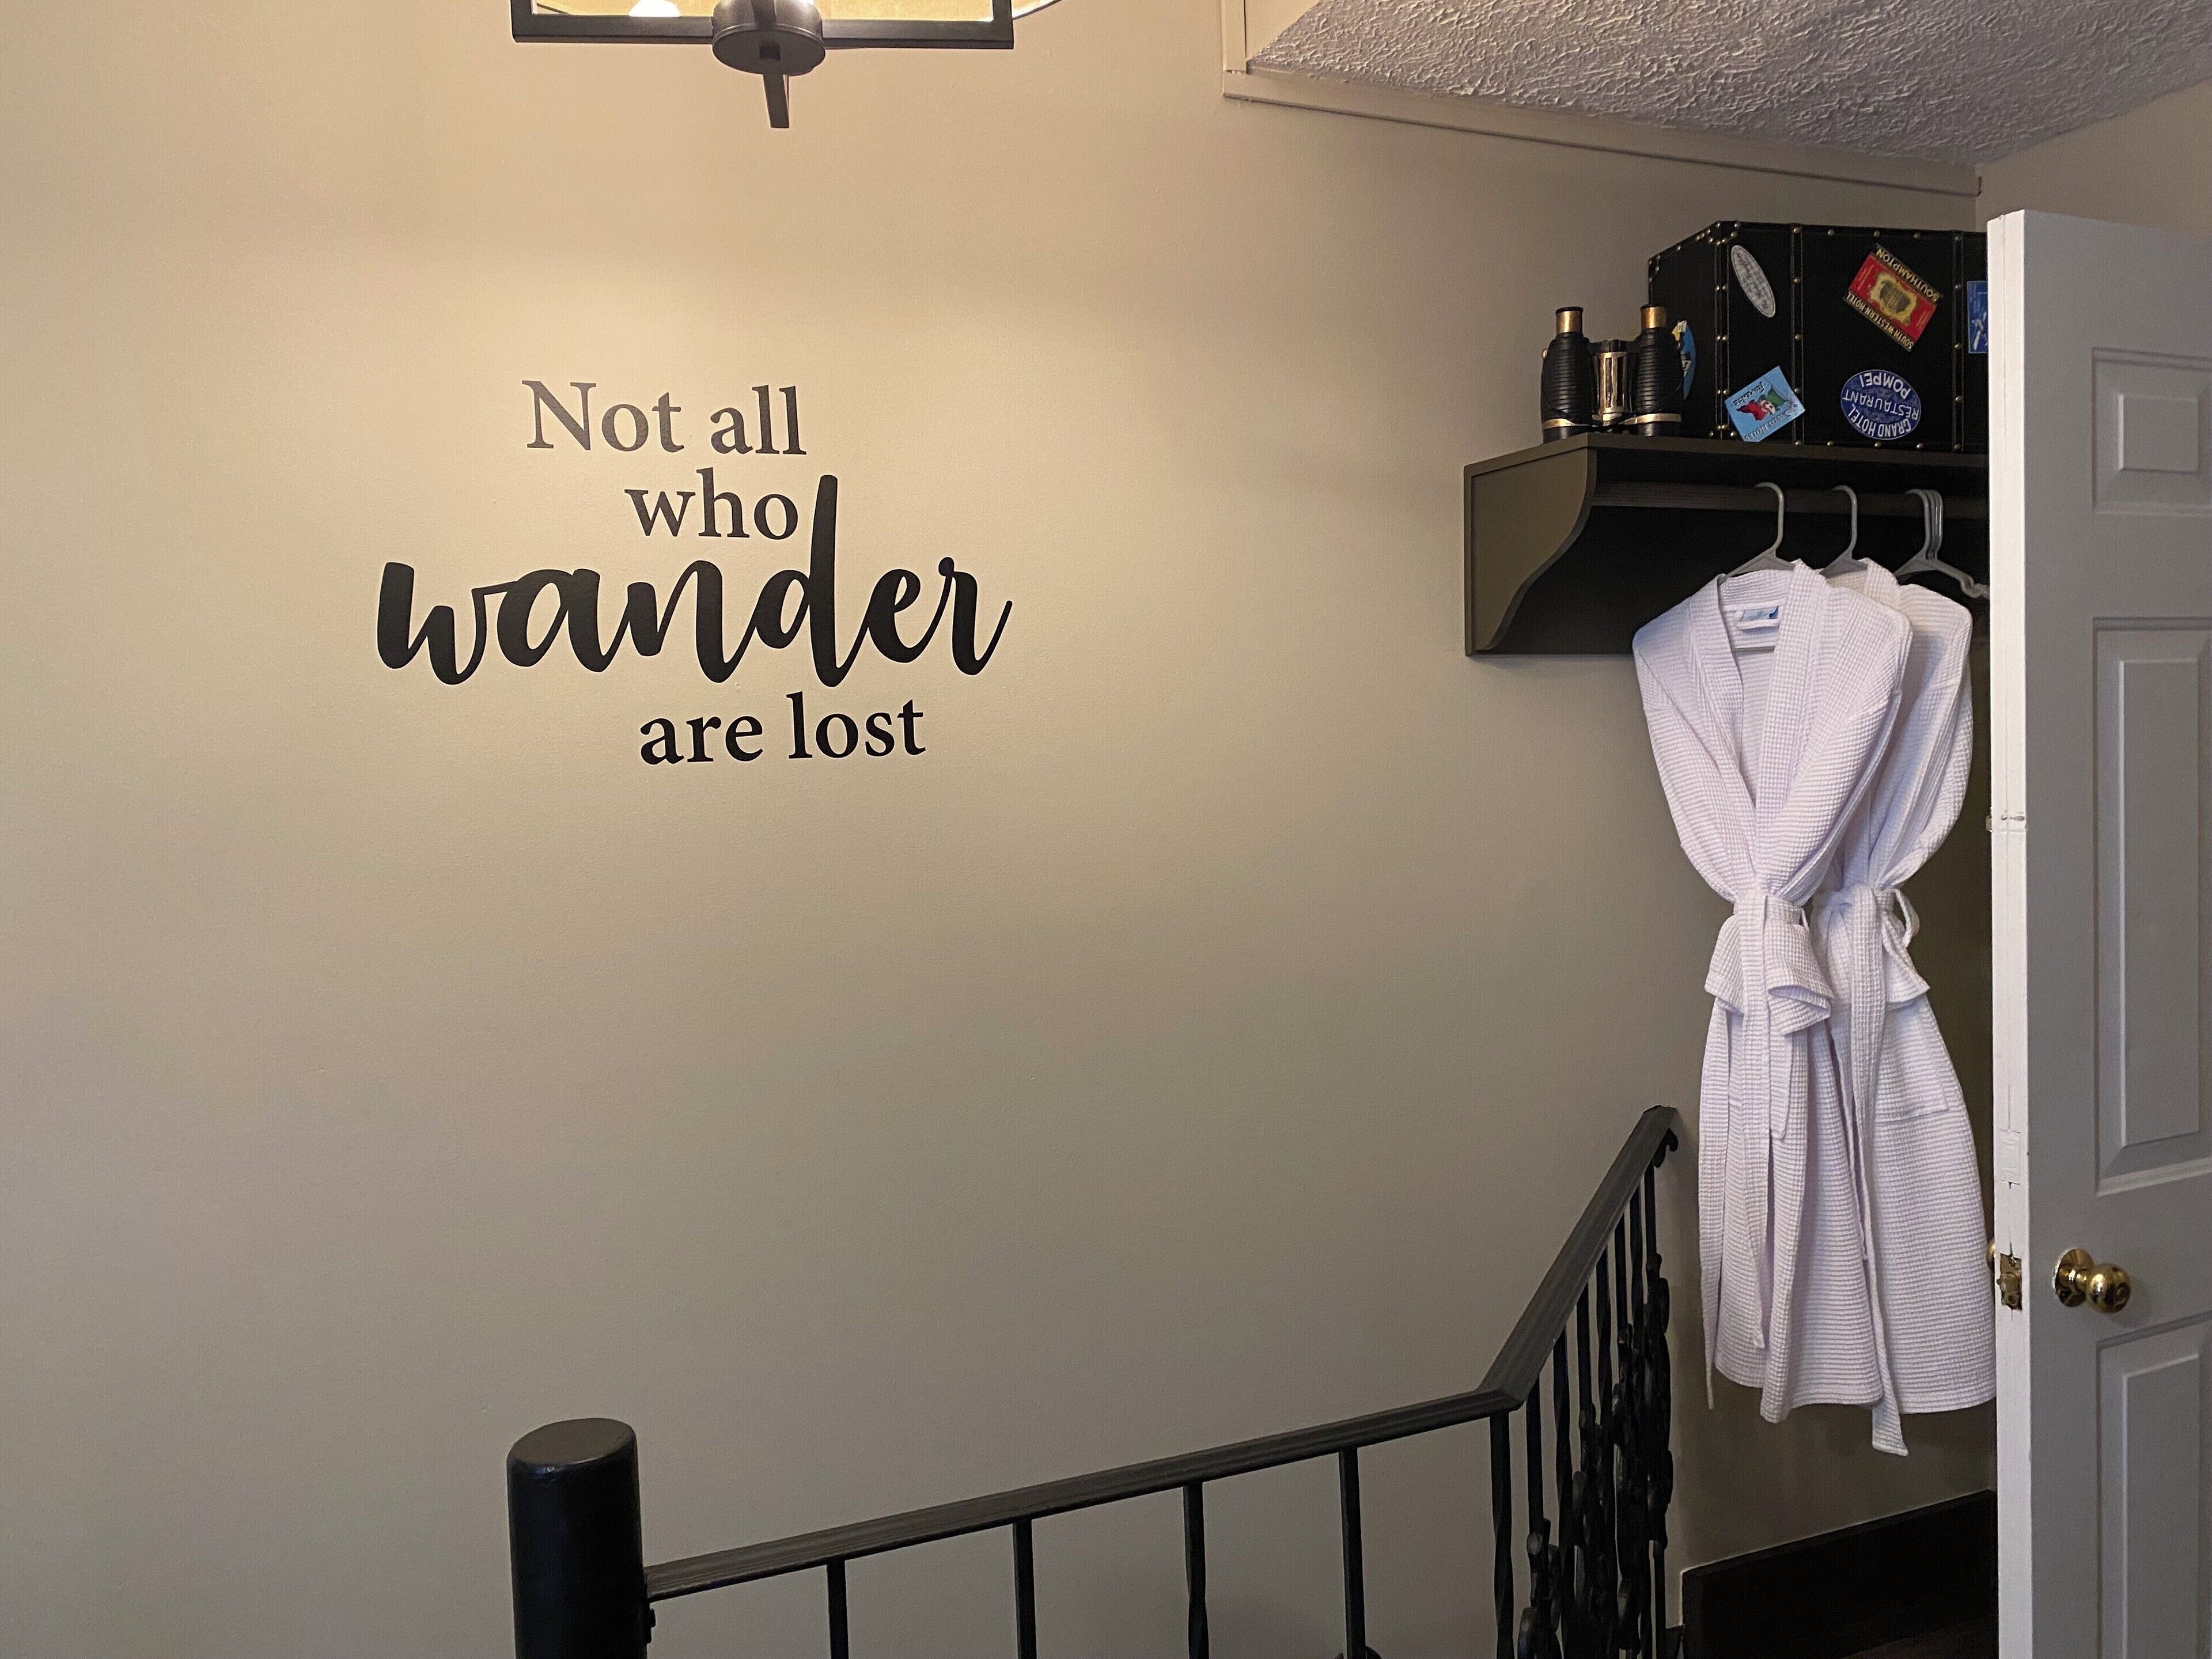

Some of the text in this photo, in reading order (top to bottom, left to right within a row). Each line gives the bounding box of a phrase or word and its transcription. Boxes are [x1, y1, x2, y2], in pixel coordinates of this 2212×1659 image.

[1876, 248, 1940, 302] SOUTHAMPTON
[1846, 291, 1866, 312] HOTEL
[1842, 389, 1919, 421] RESTAURANT
[1859, 372, 1911, 399] POMPEI
[522, 380, 807, 455] Not all
[1744, 424, 1770, 442] HOTEL
[1848, 403, 1912, 437] GRAND HOTEL
[624, 467, 799, 541] who
[377, 474, 1013, 688] wander
[640, 691, 926, 765] are lost
